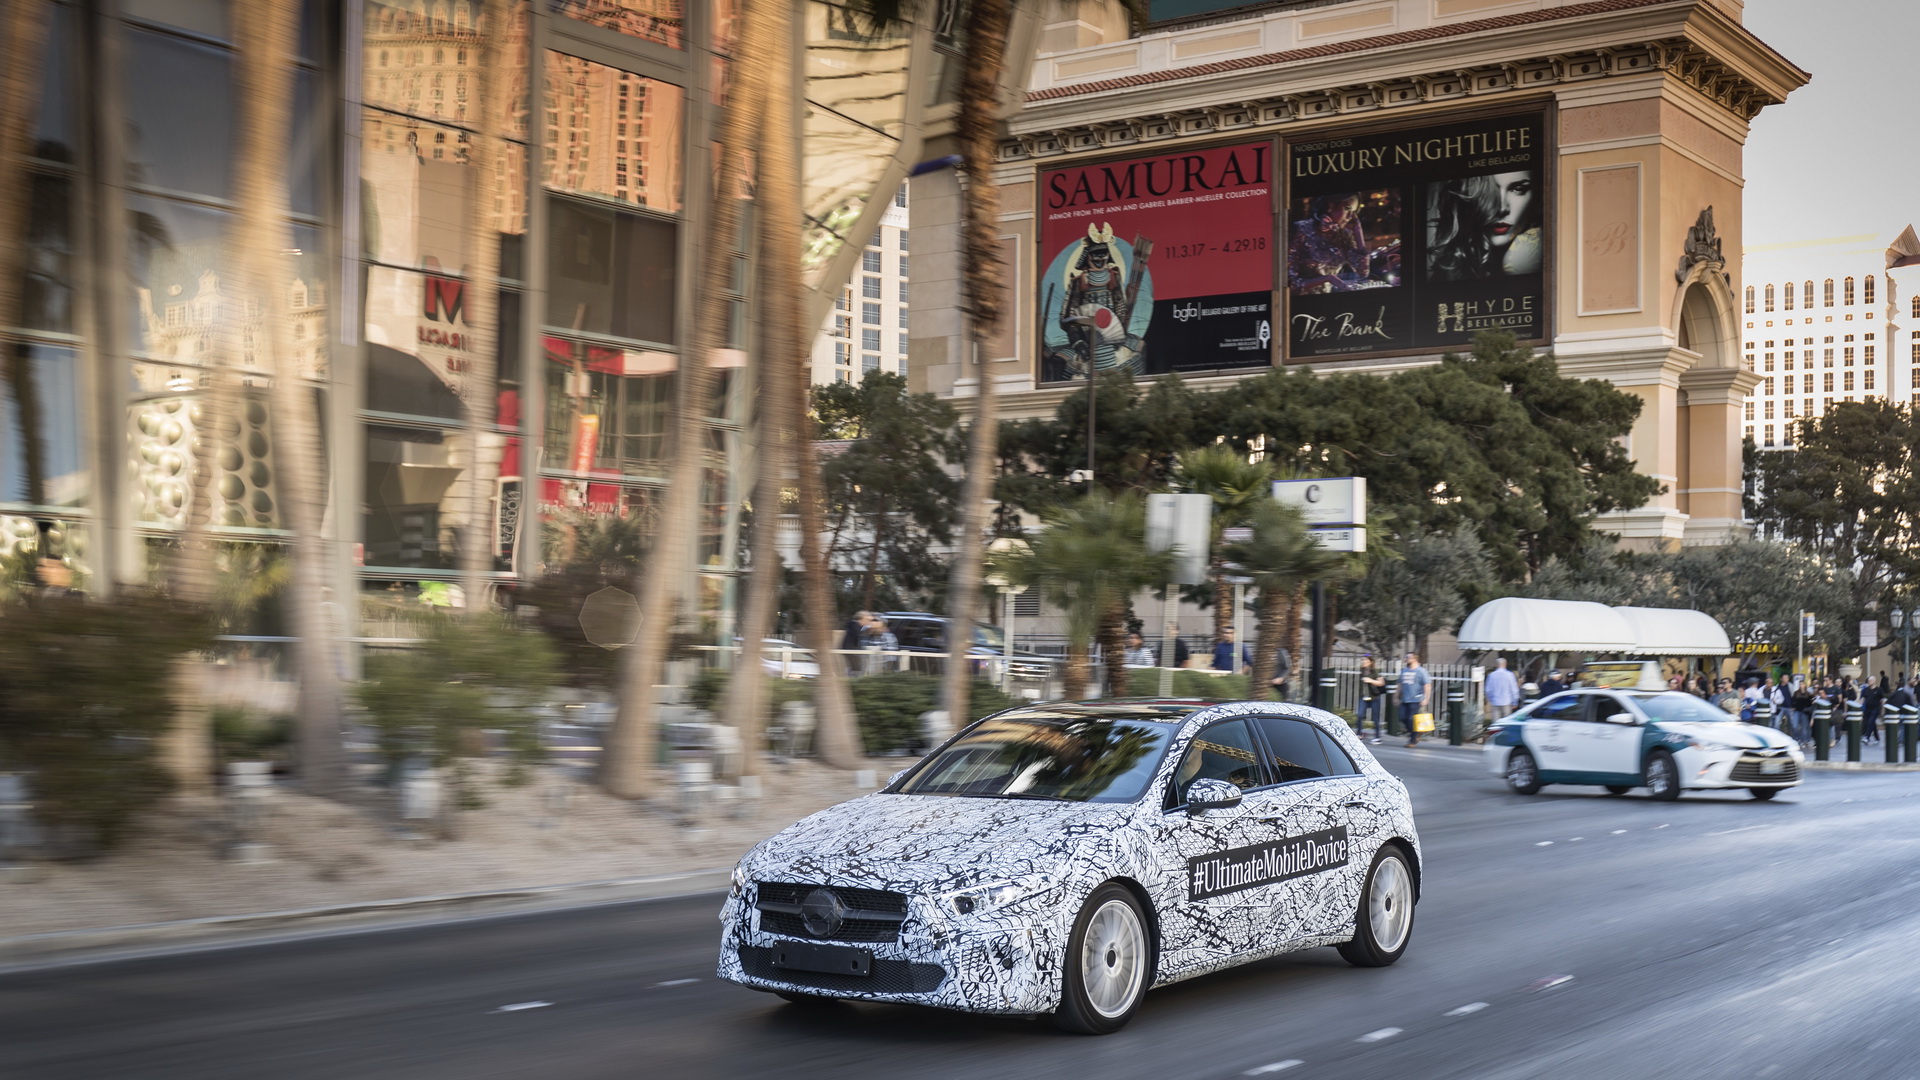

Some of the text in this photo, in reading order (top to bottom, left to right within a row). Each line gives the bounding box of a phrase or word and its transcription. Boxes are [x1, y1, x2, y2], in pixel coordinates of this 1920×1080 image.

[1294, 138, 1353, 152] NOBODY DOES
[1295, 127, 1531, 177] LUXURY NIGHTLIFE
[1468, 153, 1531, 169] LIKE BELLAGIO
[1048, 146, 1268, 210] SAMURAI
[1048, 211, 1072, 220] ARMOR
[1073, 208, 1092, 217] FROM
[1123, 203, 1138, 211] AND
[1139, 200, 1166, 209] GABRIEL
[1167, 194, 1224, 206] BARBIER-MUELLER
[1225, 188, 1268, 199] COLLECTION
[1166, 243, 1206, 259] 11.3.17
[1222, 237, 1266, 253] 4.29.18
[1172, 302, 1198, 322] bgfa
[1466, 295, 1533, 315] HYDE
[1292, 312, 1332, 342] The
[1335, 305, 1394, 340] Bank
[1466, 315, 1533, 328] BELLAGIO
[1305, 484, 1320, 503] C
[1193, 835, 1347, 895] #UltimateMobileDevice
